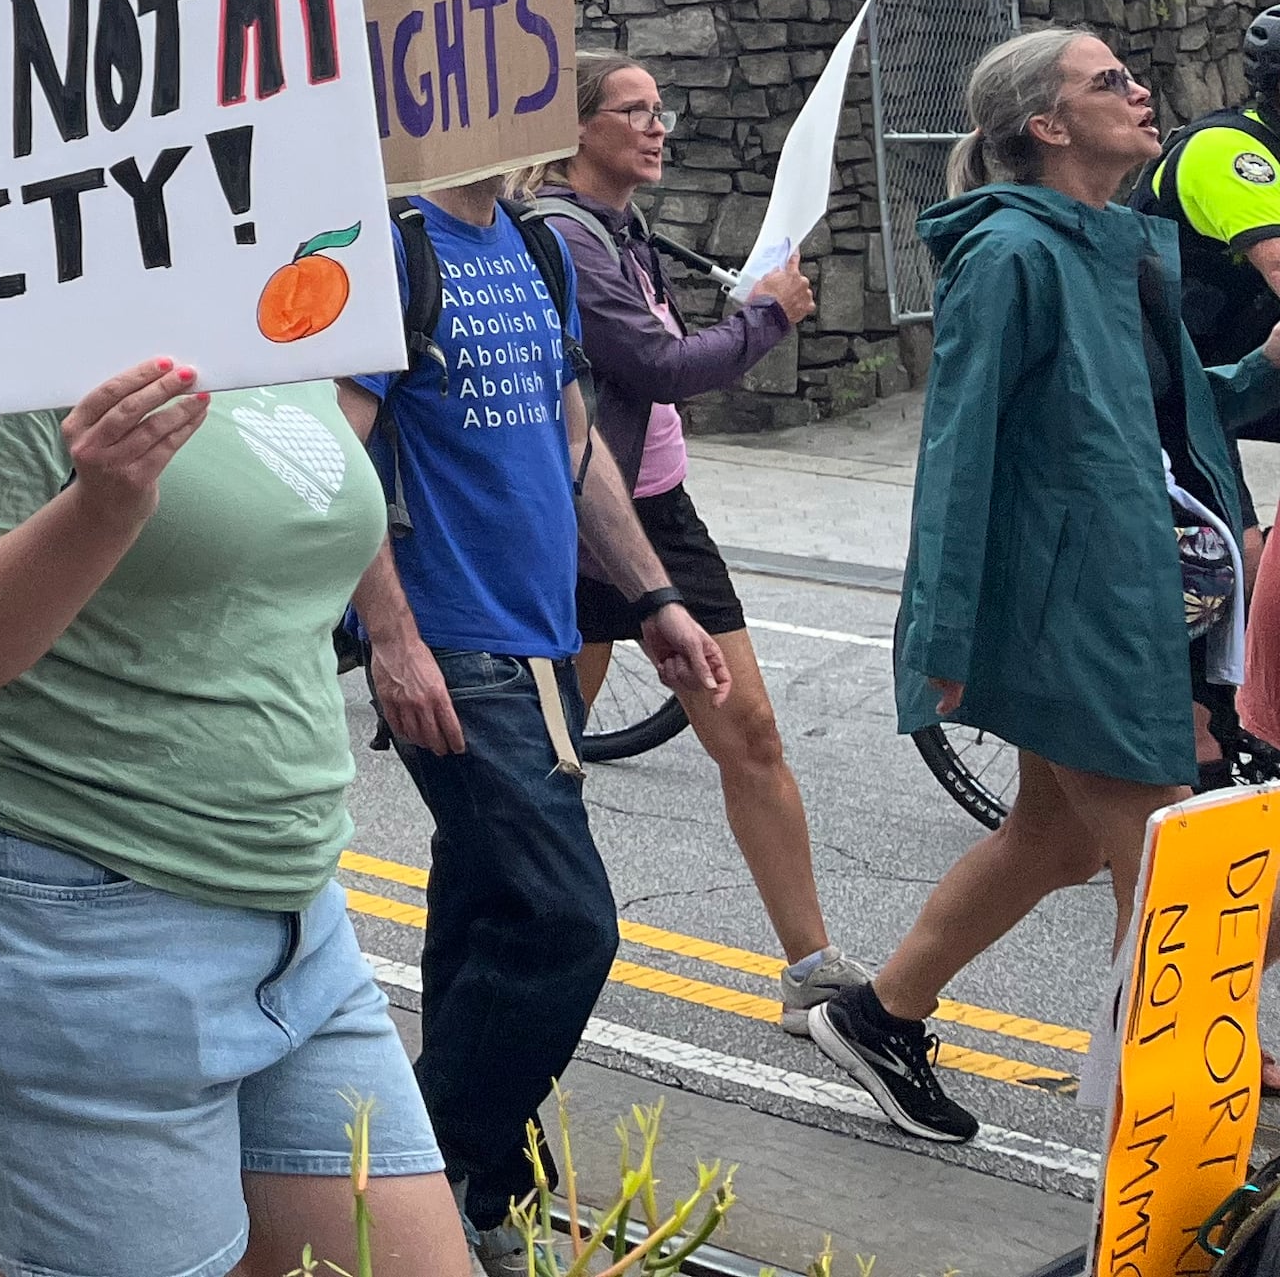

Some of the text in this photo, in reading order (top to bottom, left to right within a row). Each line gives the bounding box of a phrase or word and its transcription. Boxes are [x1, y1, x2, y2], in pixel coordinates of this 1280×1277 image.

[441, 280, 527, 309] Abolish
[451, 311, 537, 339] Abolish
[457, 341, 542, 369] Abolish
[460, 371, 544, 399] Abolish
[463, 402, 549, 429] Abolish
[1139, 904, 1189, 1046] NOT
[1196, 848, 1272, 1174] DEPORT
